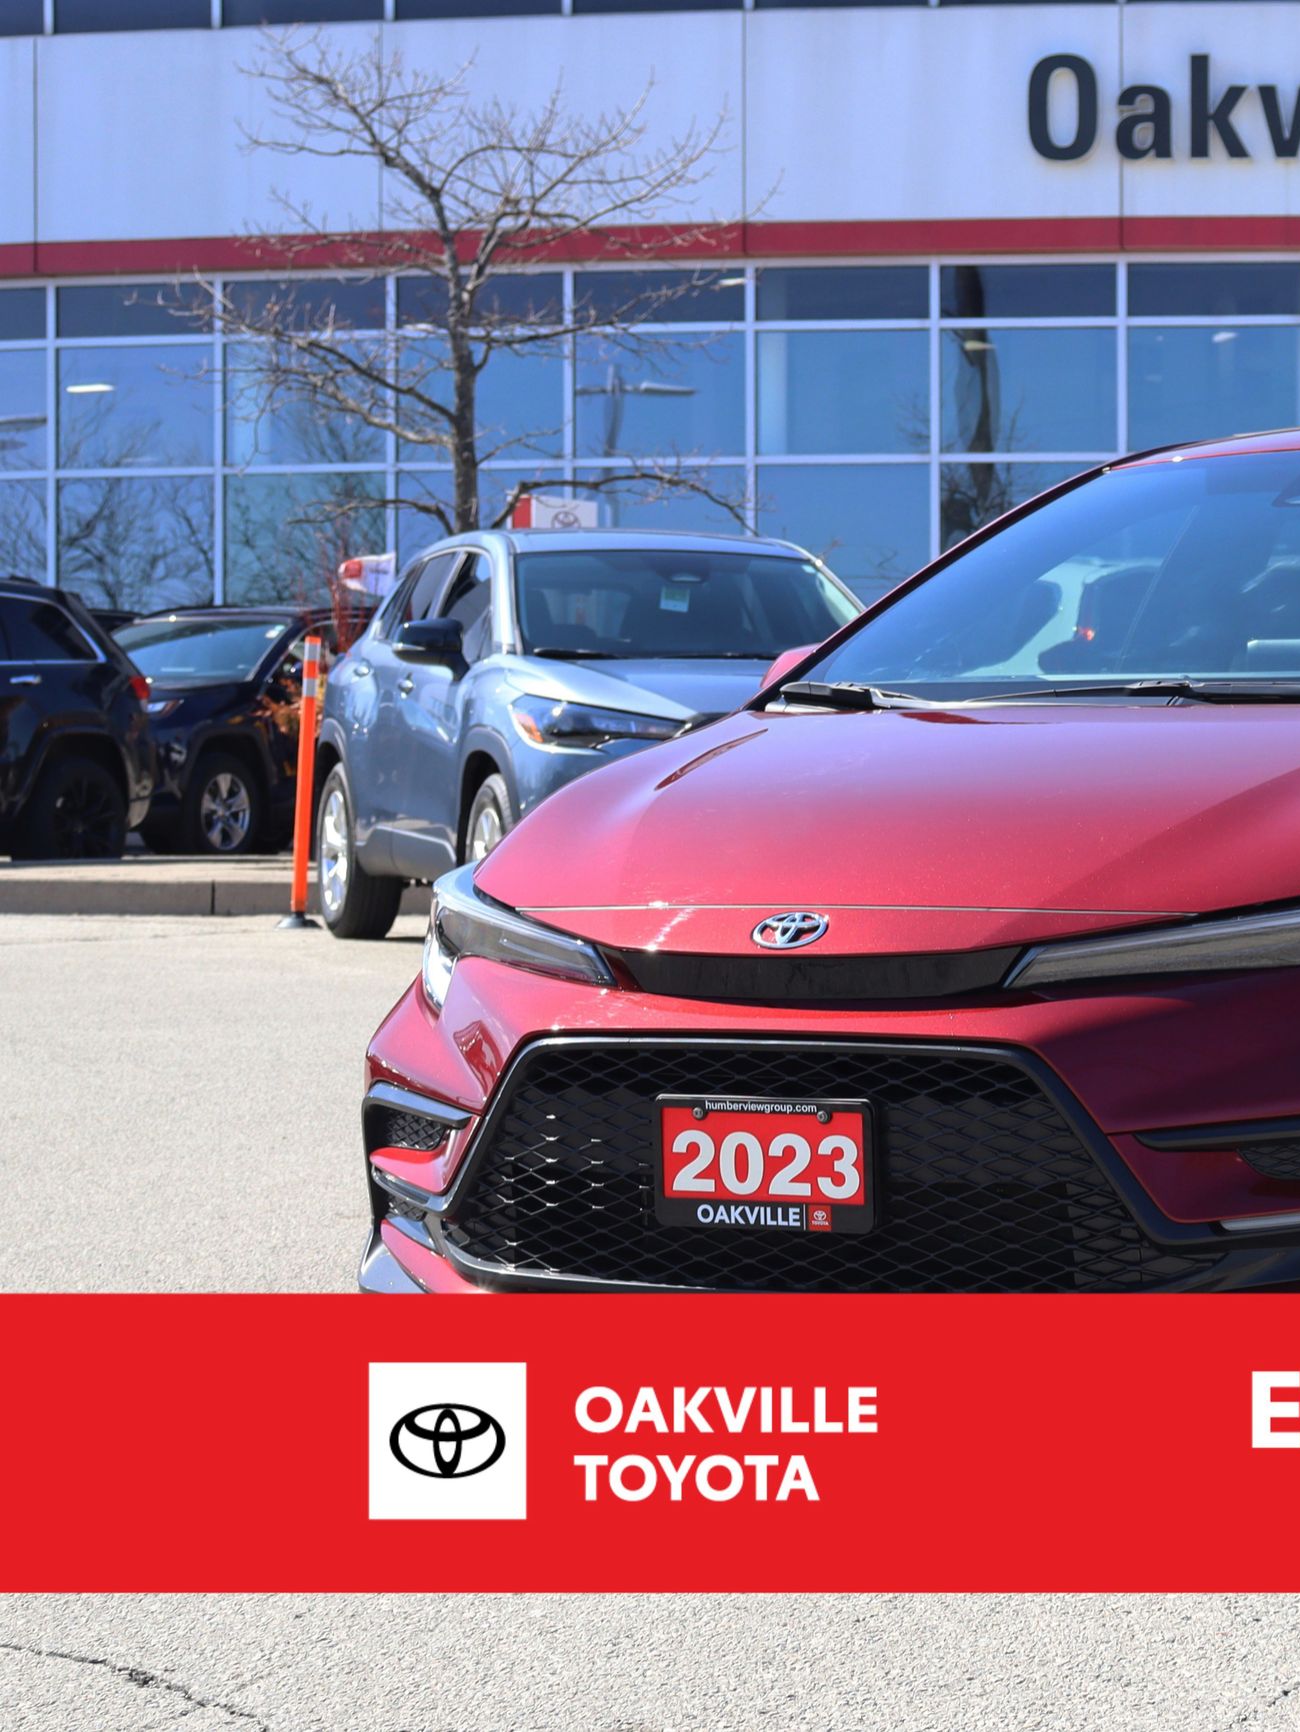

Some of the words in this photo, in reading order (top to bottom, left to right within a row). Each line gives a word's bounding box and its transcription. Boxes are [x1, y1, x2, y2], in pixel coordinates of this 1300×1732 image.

[705, 1100, 817, 1114] humberviewgroup.com
[672, 1129, 860, 1200] 2023
[696, 1204, 801, 1227] OAKVILLE
